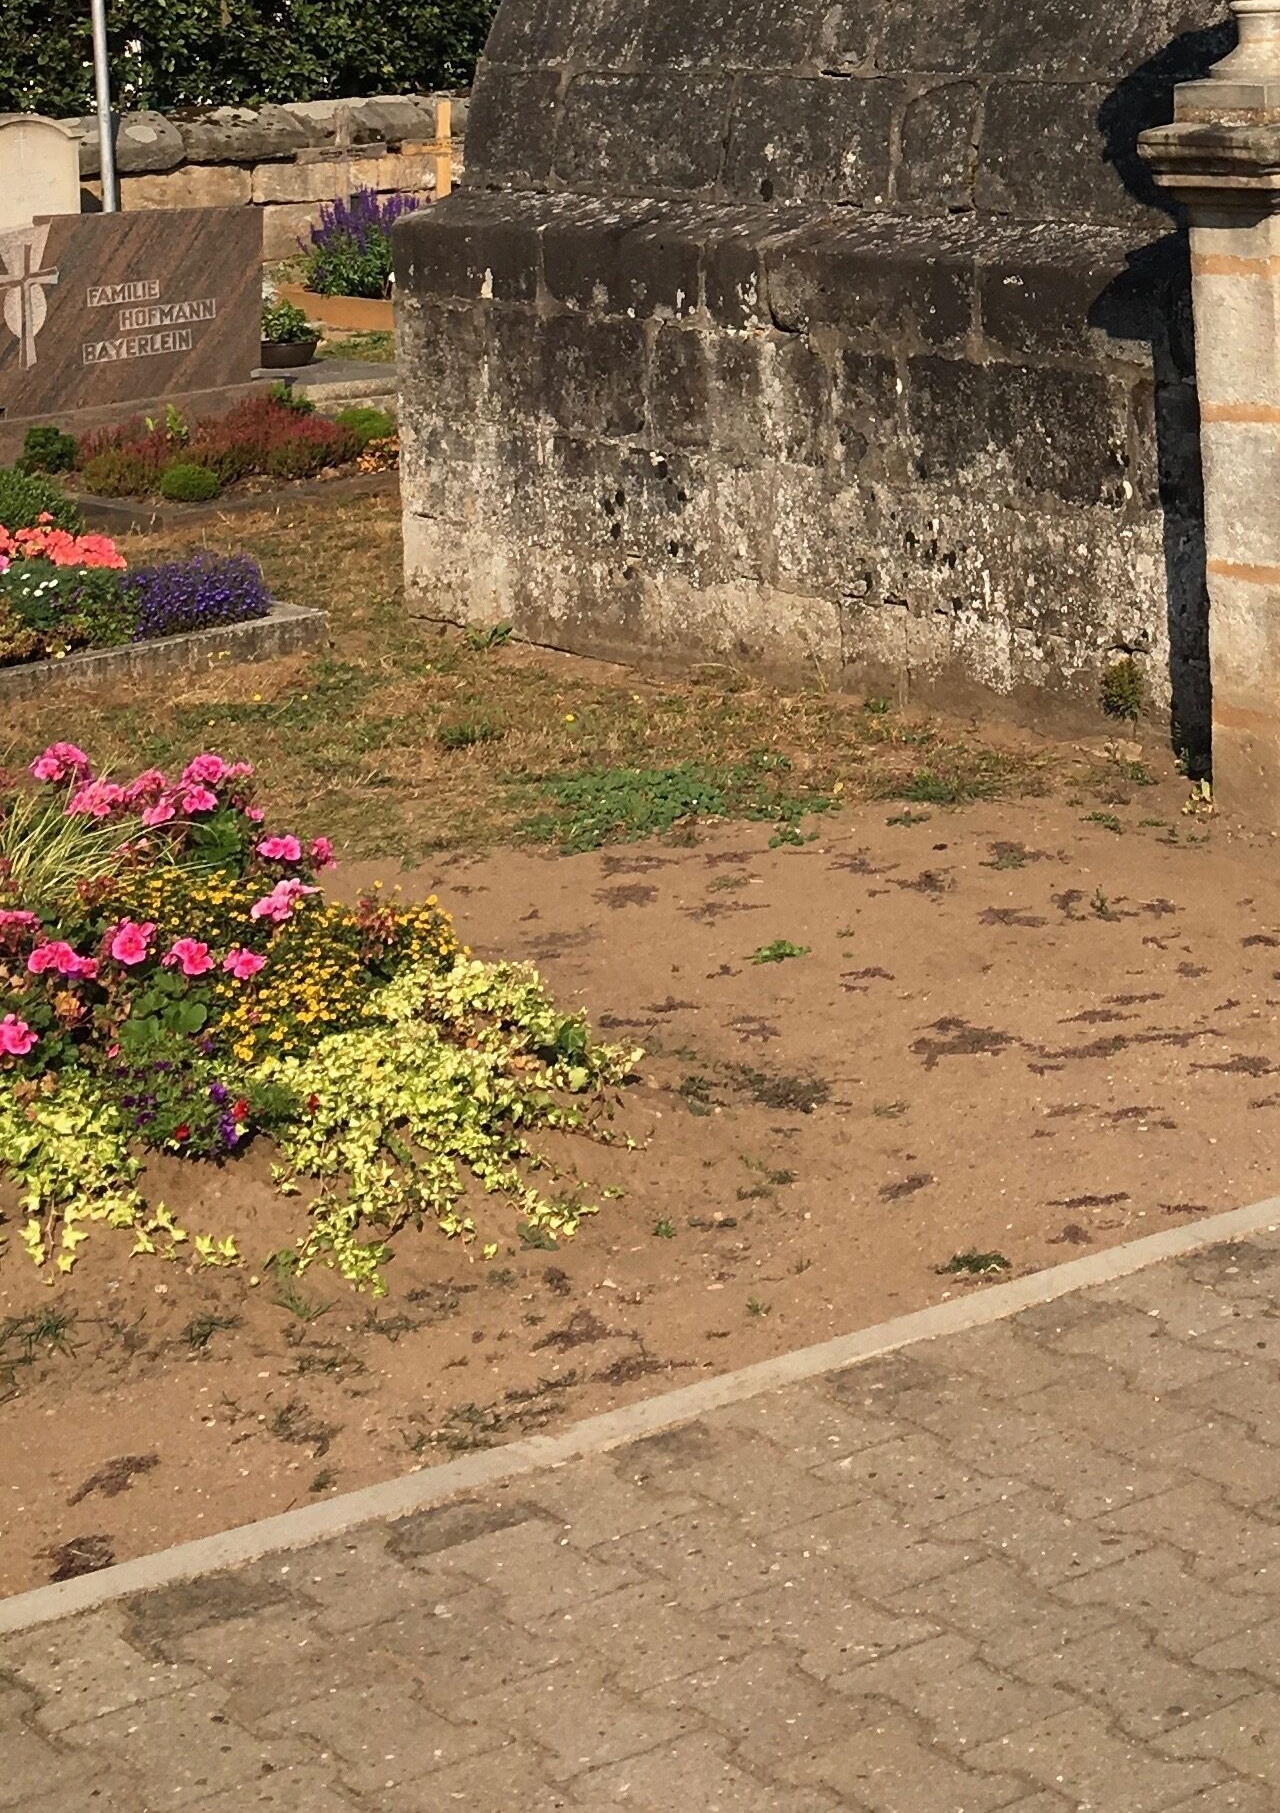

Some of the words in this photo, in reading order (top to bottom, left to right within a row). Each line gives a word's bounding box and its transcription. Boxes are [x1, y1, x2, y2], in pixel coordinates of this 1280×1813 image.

[87, 279, 160, 307] FAMILIE
[119, 298, 216, 330] HOFMANN
[82, 329, 192, 364] BAYERLEIN
